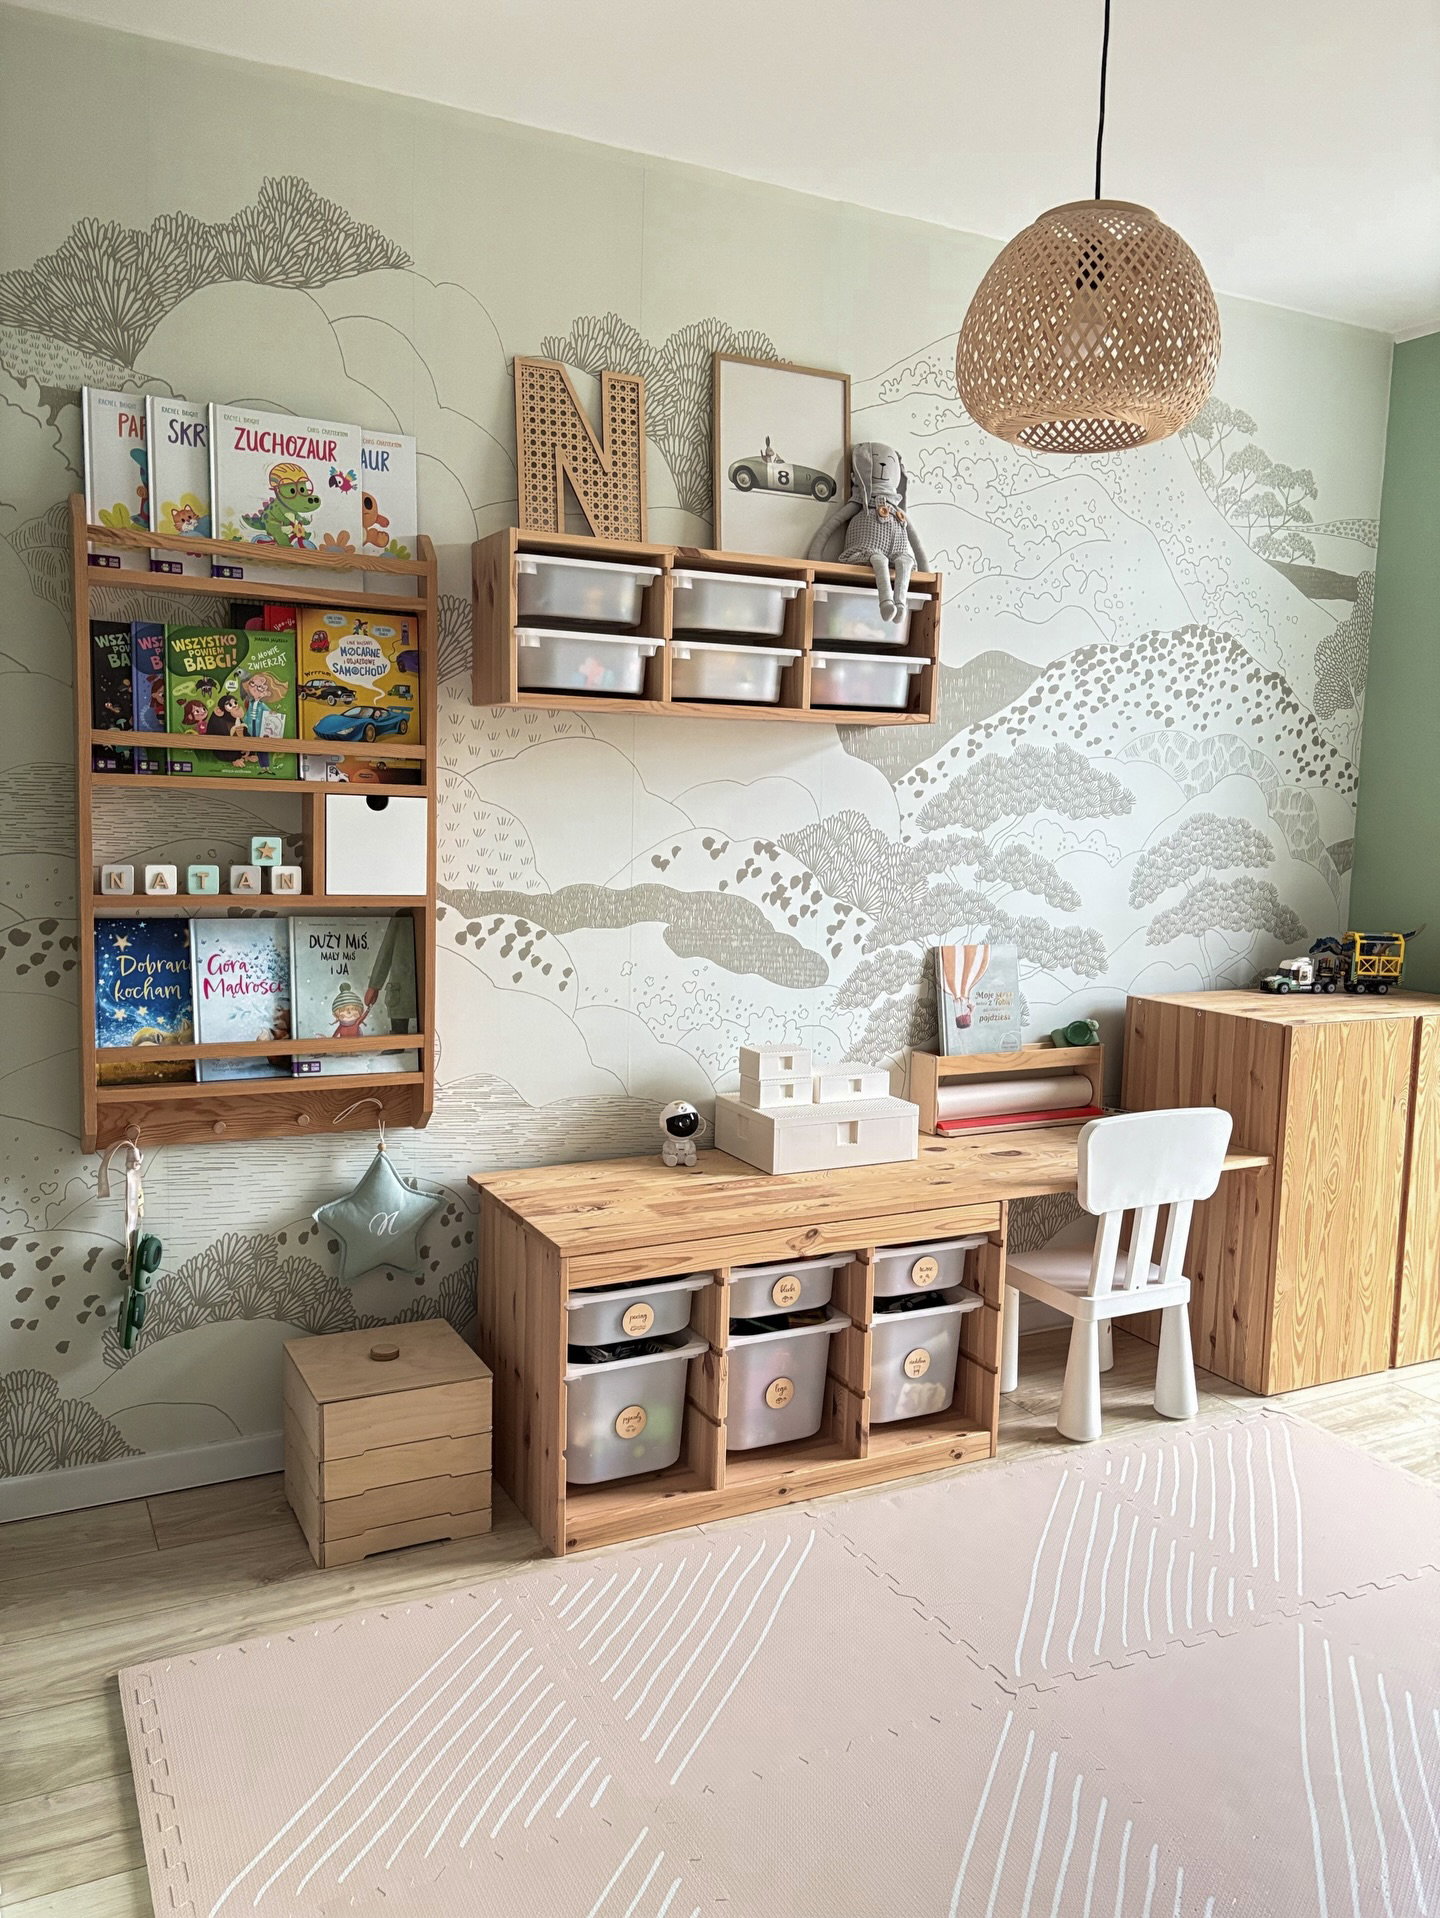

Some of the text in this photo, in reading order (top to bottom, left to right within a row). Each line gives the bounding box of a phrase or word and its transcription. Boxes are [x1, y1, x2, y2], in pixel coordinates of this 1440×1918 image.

[167, 418, 209, 448] SKR
[233, 427, 338, 463] ZUCHOZAUR
[513, 356, 648, 541] N
[777, 470, 790, 486] 8
[171, 634, 237, 652] WSZYSTKO
[188, 646, 225, 657] POWIEM
[183, 647, 237, 673] BABCI!
[247, 652, 287, 671] ZWIERZĄT
[257, 645, 280, 661] MOWIE
[332, 662, 388, 677] SAMOCHODY
[309, 931, 341, 949] DUŻY
[206, 953, 250, 976] Góra
[336, 962, 350, 975] JA
[114, 976, 182, 1002] kocham
[203, 975, 284, 1000] Mądrości
